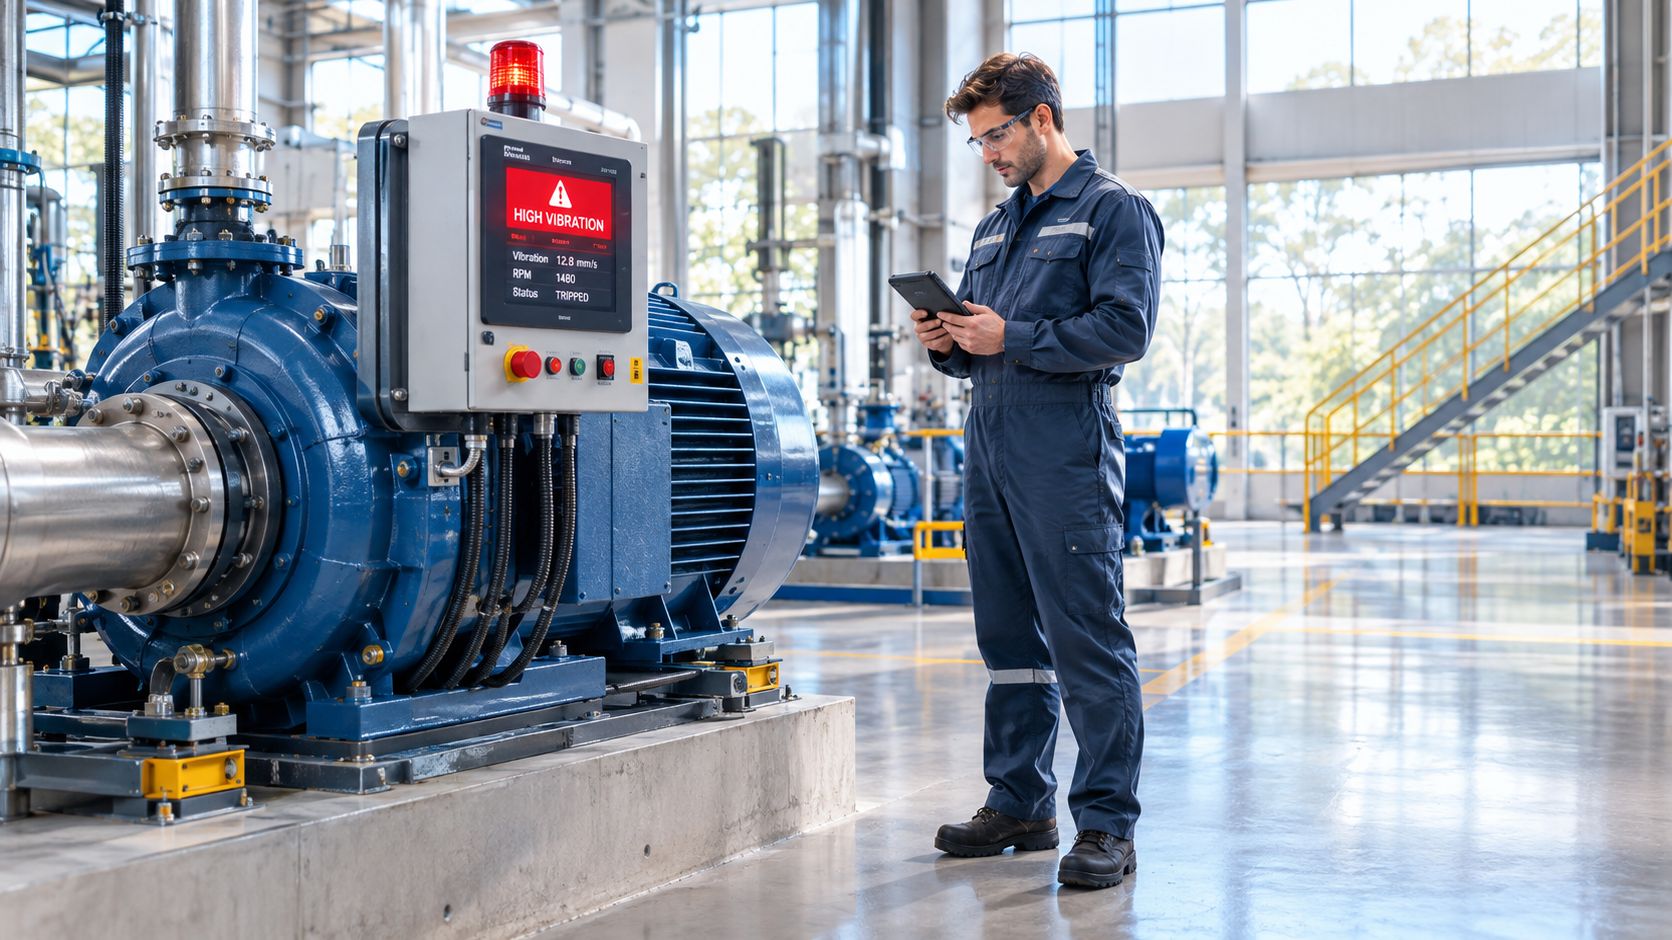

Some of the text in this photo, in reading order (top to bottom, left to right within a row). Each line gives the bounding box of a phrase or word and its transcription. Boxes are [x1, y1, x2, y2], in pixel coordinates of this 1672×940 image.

[514, 208, 604, 231] HIGH VIBRATION
[512, 251, 598, 269] Vibration 12.8 mm/s
[512, 268, 576, 284] RPM 1480
[512, 287, 589, 302] Status TRIPPED
